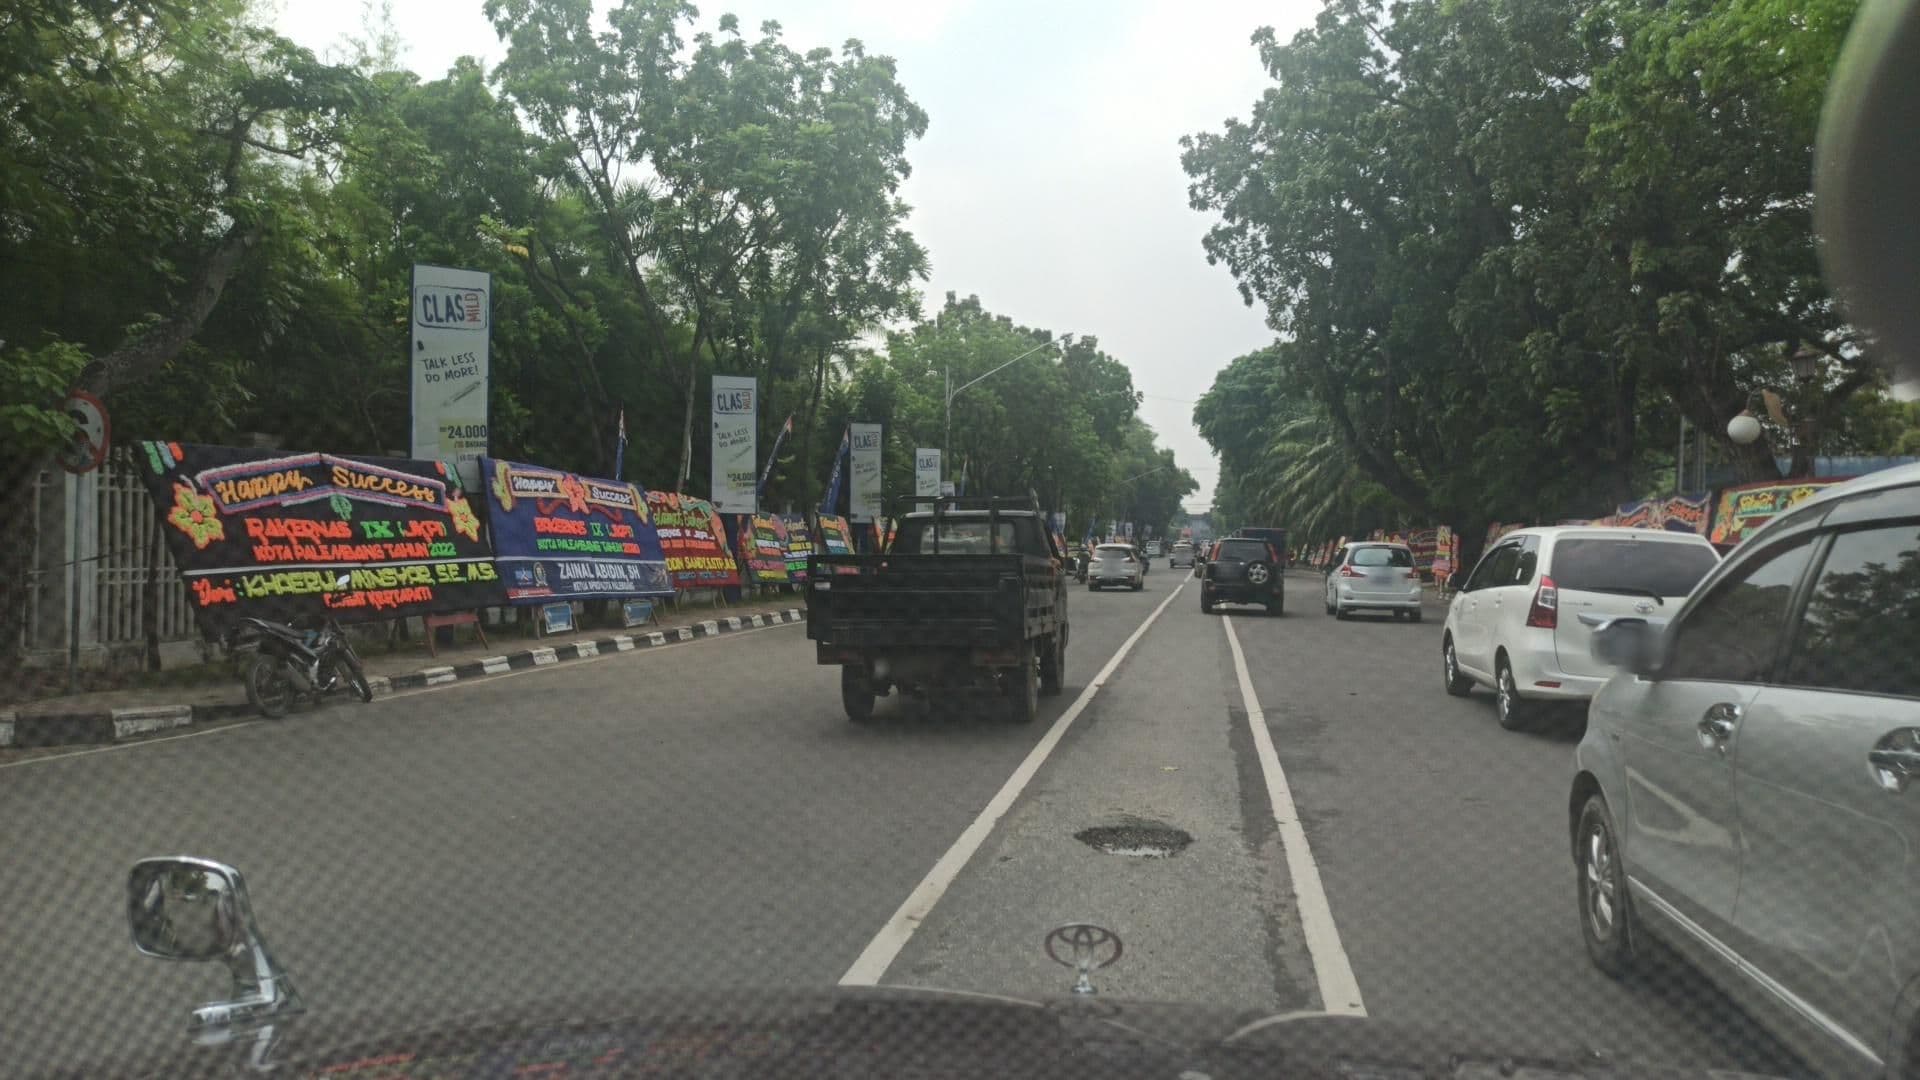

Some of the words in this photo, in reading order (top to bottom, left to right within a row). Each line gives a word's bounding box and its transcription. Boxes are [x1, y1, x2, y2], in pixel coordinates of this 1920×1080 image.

[423, 294, 465, 323] CLAS
[464, 293, 481, 323] MILD
[423, 357, 448, 371] TALK
[451, 351, 476, 366] LESS
[425, 373, 440, 384] DO
[445, 365, 479, 382] MORE!
[717, 393, 743, 412] CLAS
[447, 424, 487, 439] 24.000
[244, 518, 353, 545] RAKERNAS
[252, 544, 294, 561] KOTA
[292, 544, 385, 561] PALEMBANG
[383, 542, 430, 559] TAHUN
[428, 542, 457, 557] 2022
[558, 561, 595, 580] ZAINAL
